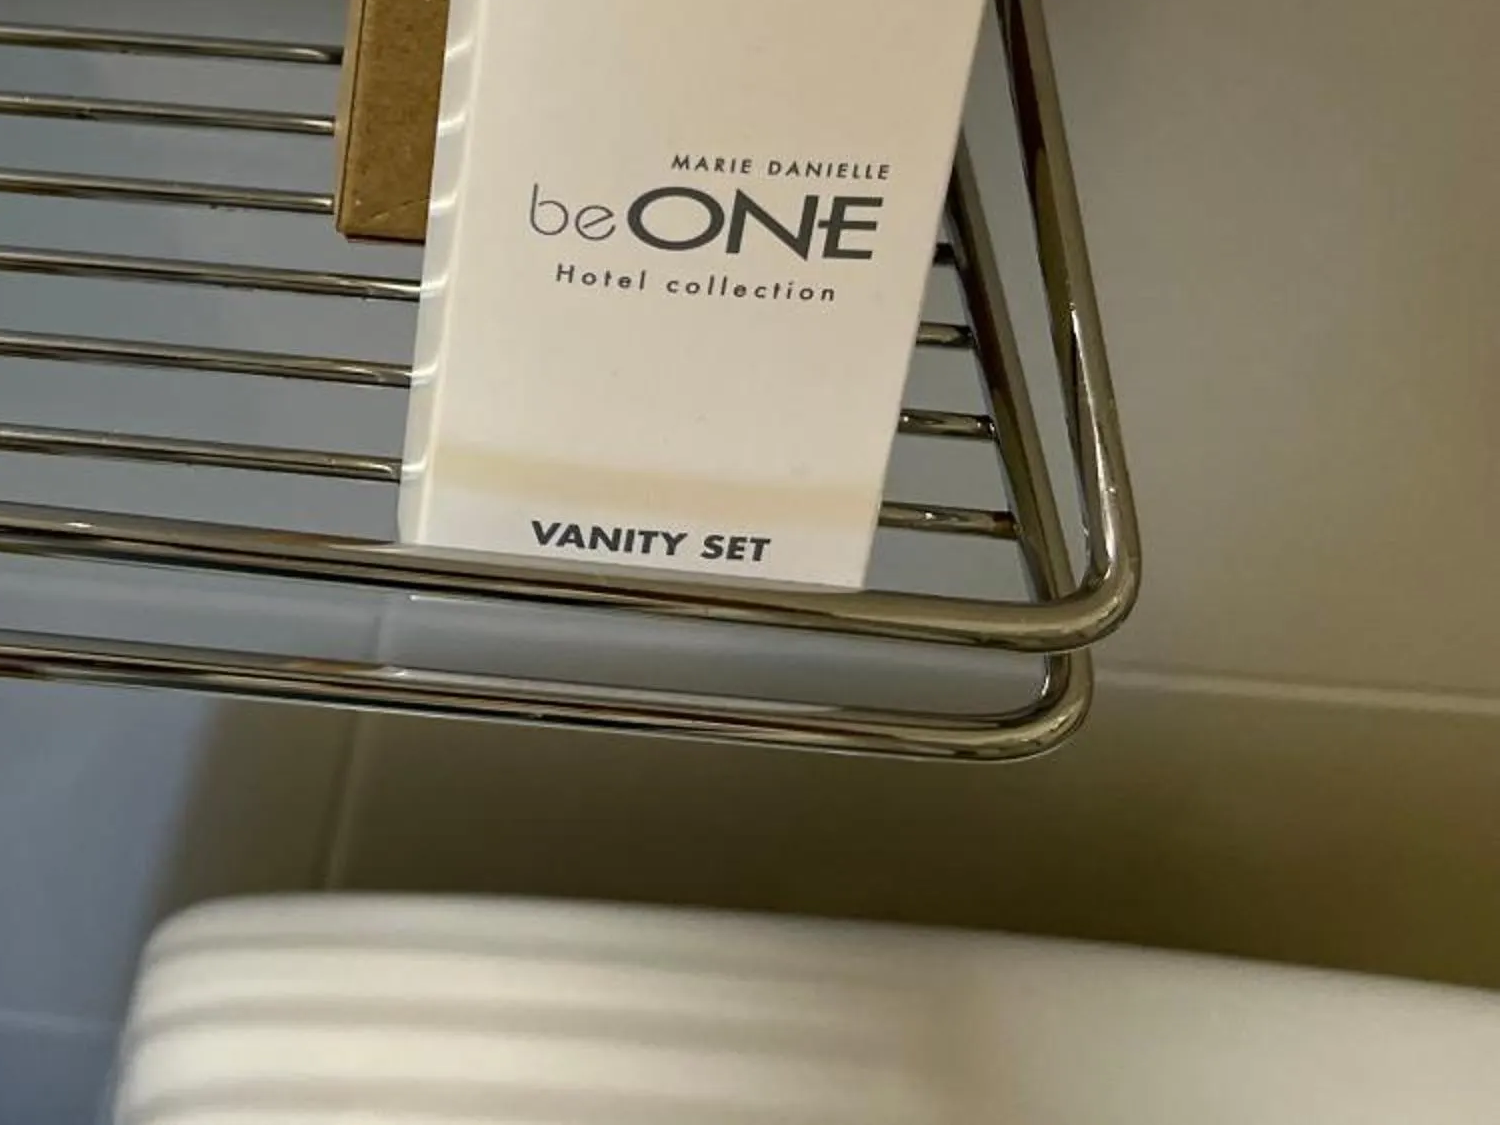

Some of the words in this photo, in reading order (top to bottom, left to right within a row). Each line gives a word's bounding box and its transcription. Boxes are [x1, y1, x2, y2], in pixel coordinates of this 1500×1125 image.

[670, 153, 753, 175] MARIE
[767, 159, 891, 181] DANIELLE
[555, 263, 647, 291] Hotel
[666, 275, 837, 302] collection
[531, 520, 688, 556] VANITY
[701, 534, 771, 562] SET
